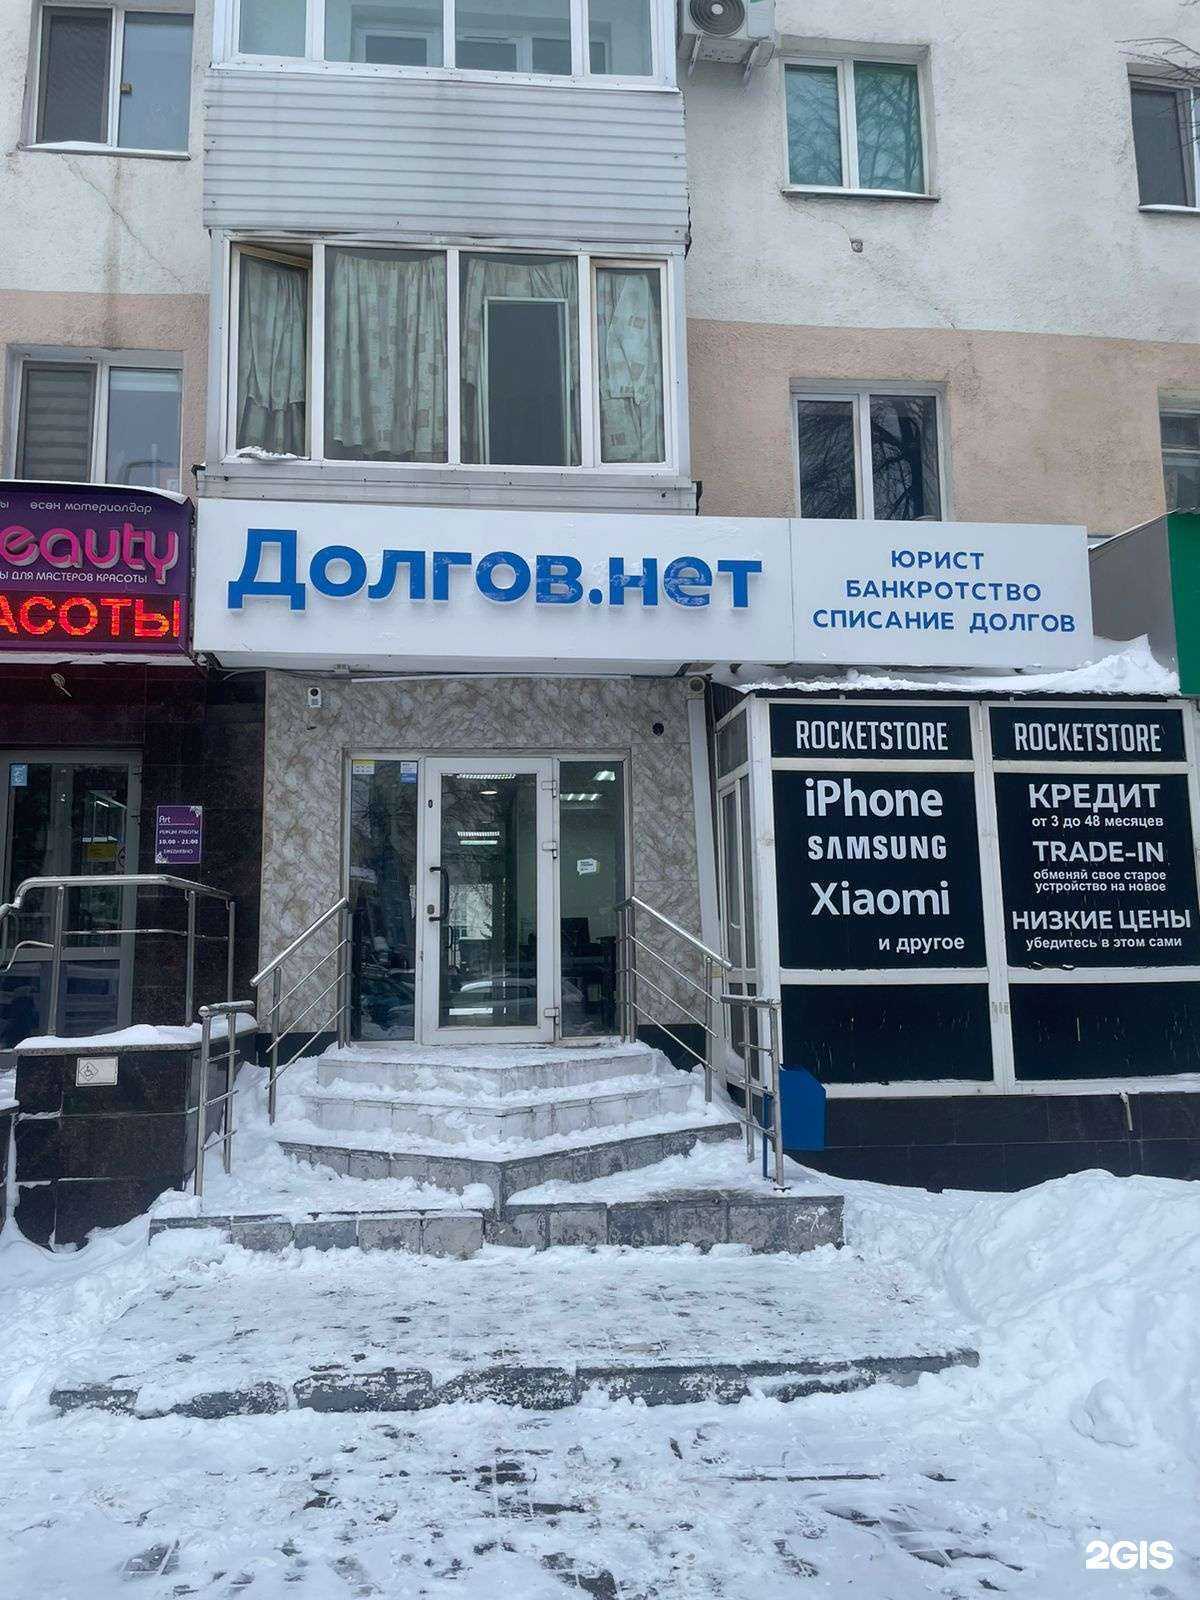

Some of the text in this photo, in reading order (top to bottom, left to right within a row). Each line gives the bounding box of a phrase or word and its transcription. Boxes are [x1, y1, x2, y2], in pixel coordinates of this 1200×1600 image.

[0, 522, 179, 585] eauty
[891, 550, 985, 570] ЮРИСТ
[11, 571, 34, 580] ДЛЯ
[36, 572, 94, 583] МАСТЕРОВ
[96, 574, 148, 584] КРАСОТЫ
[227, 528, 763, 611] Долгов.нет
[846, 580, 1042, 602] БАНКРОТСТВО
[812, 609, 1075, 633] СПИСАНИЕ ДОЛГОВ
[796, 720, 949, 751] ROCKETSTORE
[1014, 722, 1162, 752] ROCKETSTORE
[805, 778, 943, 817] iPhone
[1028, 783, 1161, 813] КРЕДИТ
[1032, 815, 1164, 829] от 3 до 48 месяцев
[808, 835, 947, 860] SAMSUNG
[1032, 841, 1165, 862] TRADE-IN
[1033, 870, 1167, 882] обменяй свое старое
[1035, 881, 1167, 894] устройство на новое
[810, 880, 950, 916] Xiaomi
[1012, 909, 1191, 932] НИЗКИЕ ЦЕНЫ
[878, 936, 965, 953] и другое
[1026, 937, 1182, 951] убедитесь в этом сами
